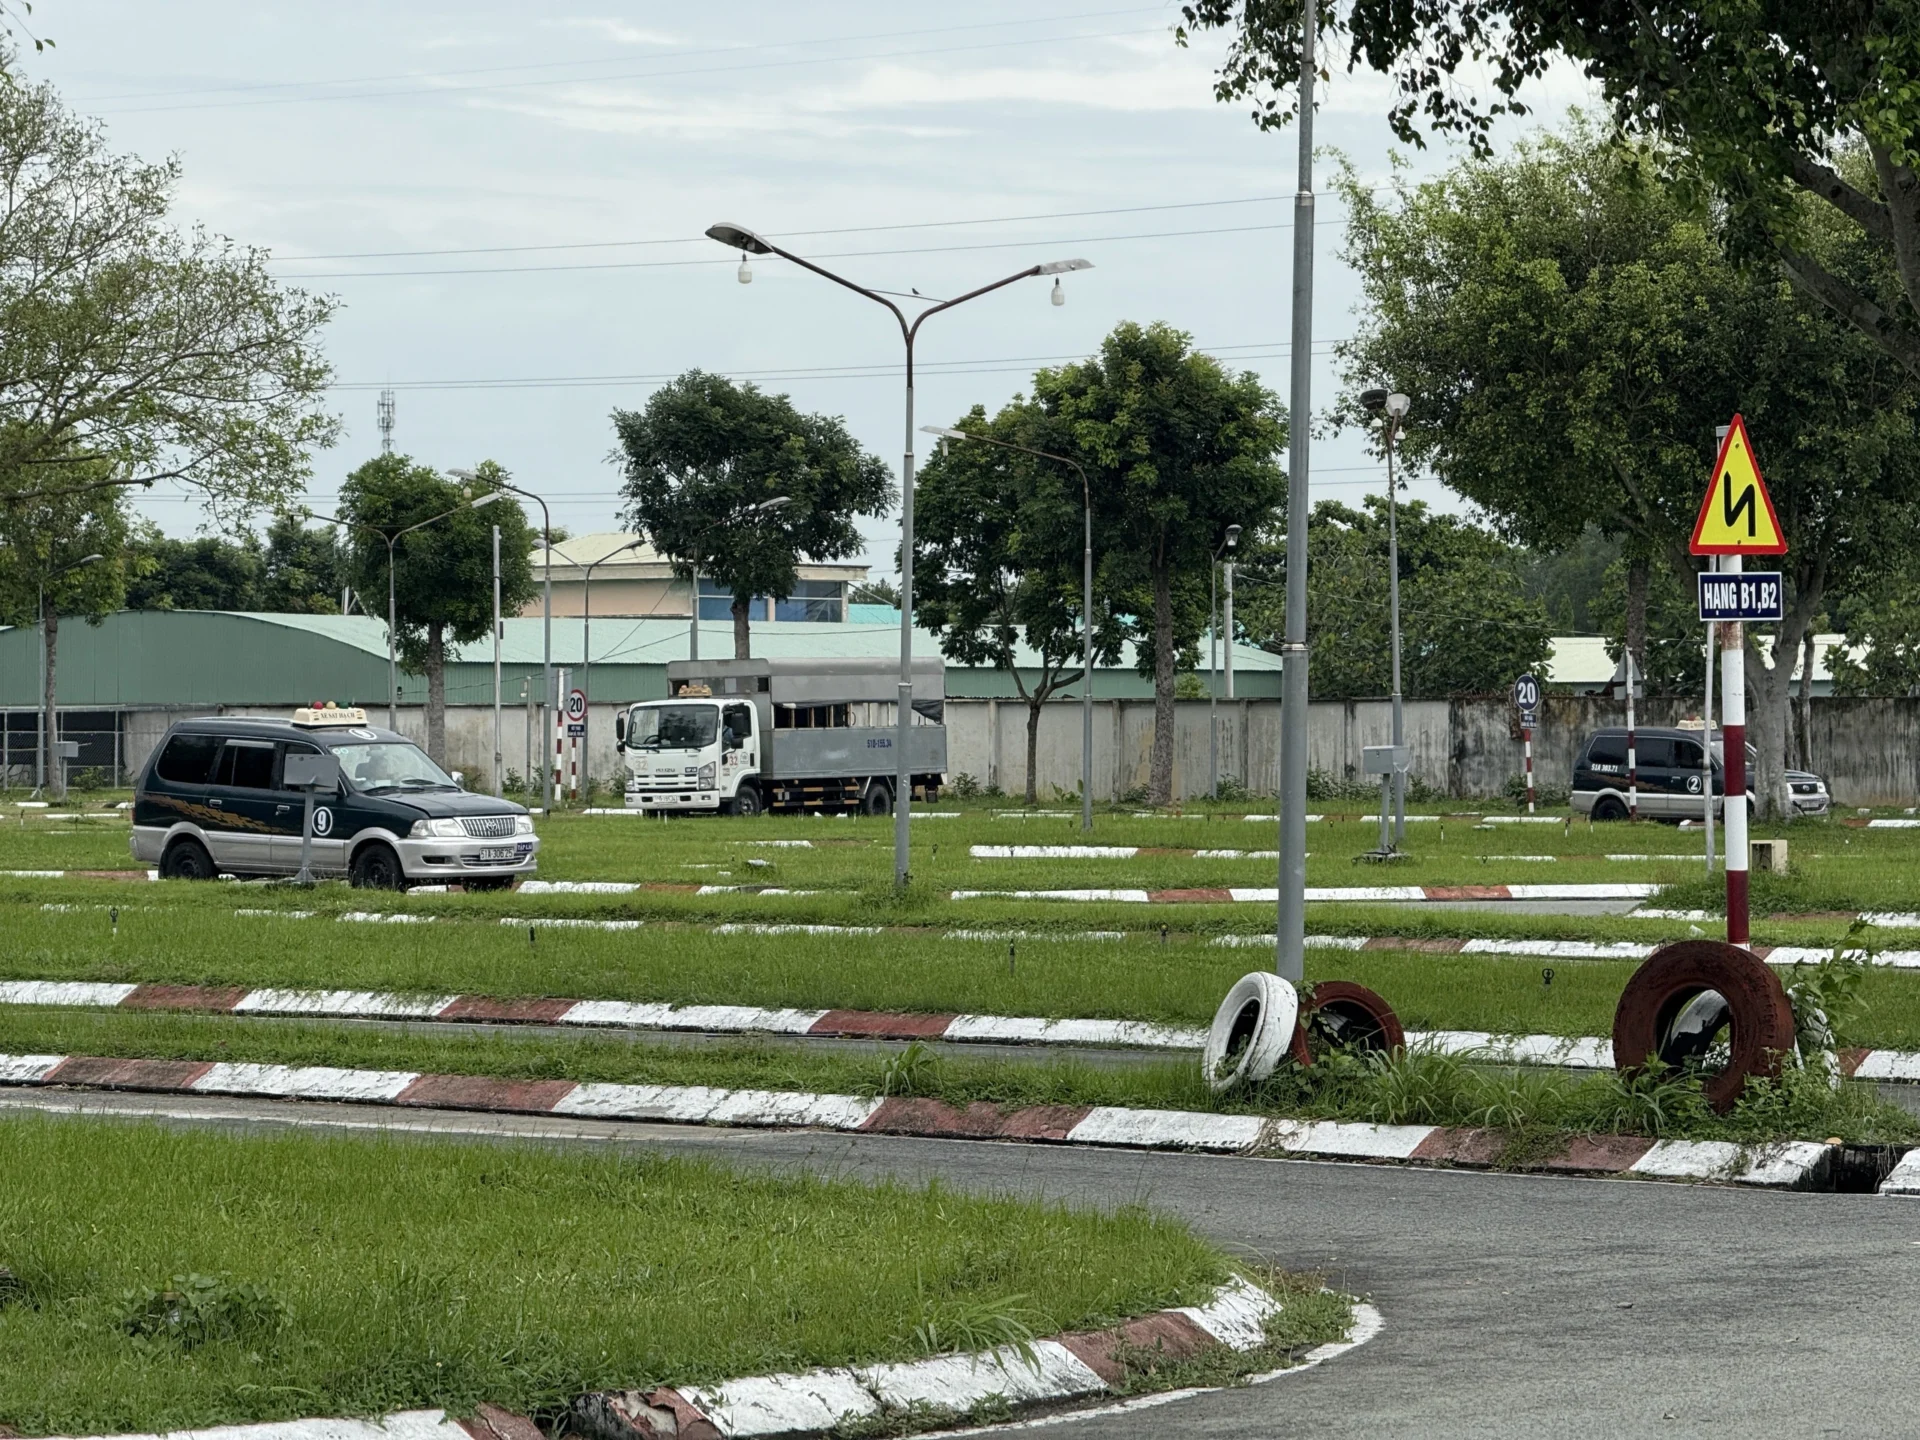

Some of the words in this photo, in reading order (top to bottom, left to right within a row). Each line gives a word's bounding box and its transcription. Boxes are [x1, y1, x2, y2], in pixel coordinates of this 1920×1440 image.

[1704, 582, 1737, 616] HẠNG
[1741, 582, 1777, 614] B1,B2
[1518, 682, 1536, 704] 20
[570, 697, 583, 713] 20
[729, 755, 738, 766] 32
[1690, 777, 1698, 791] 2
[317, 810, 326, 831] 9
